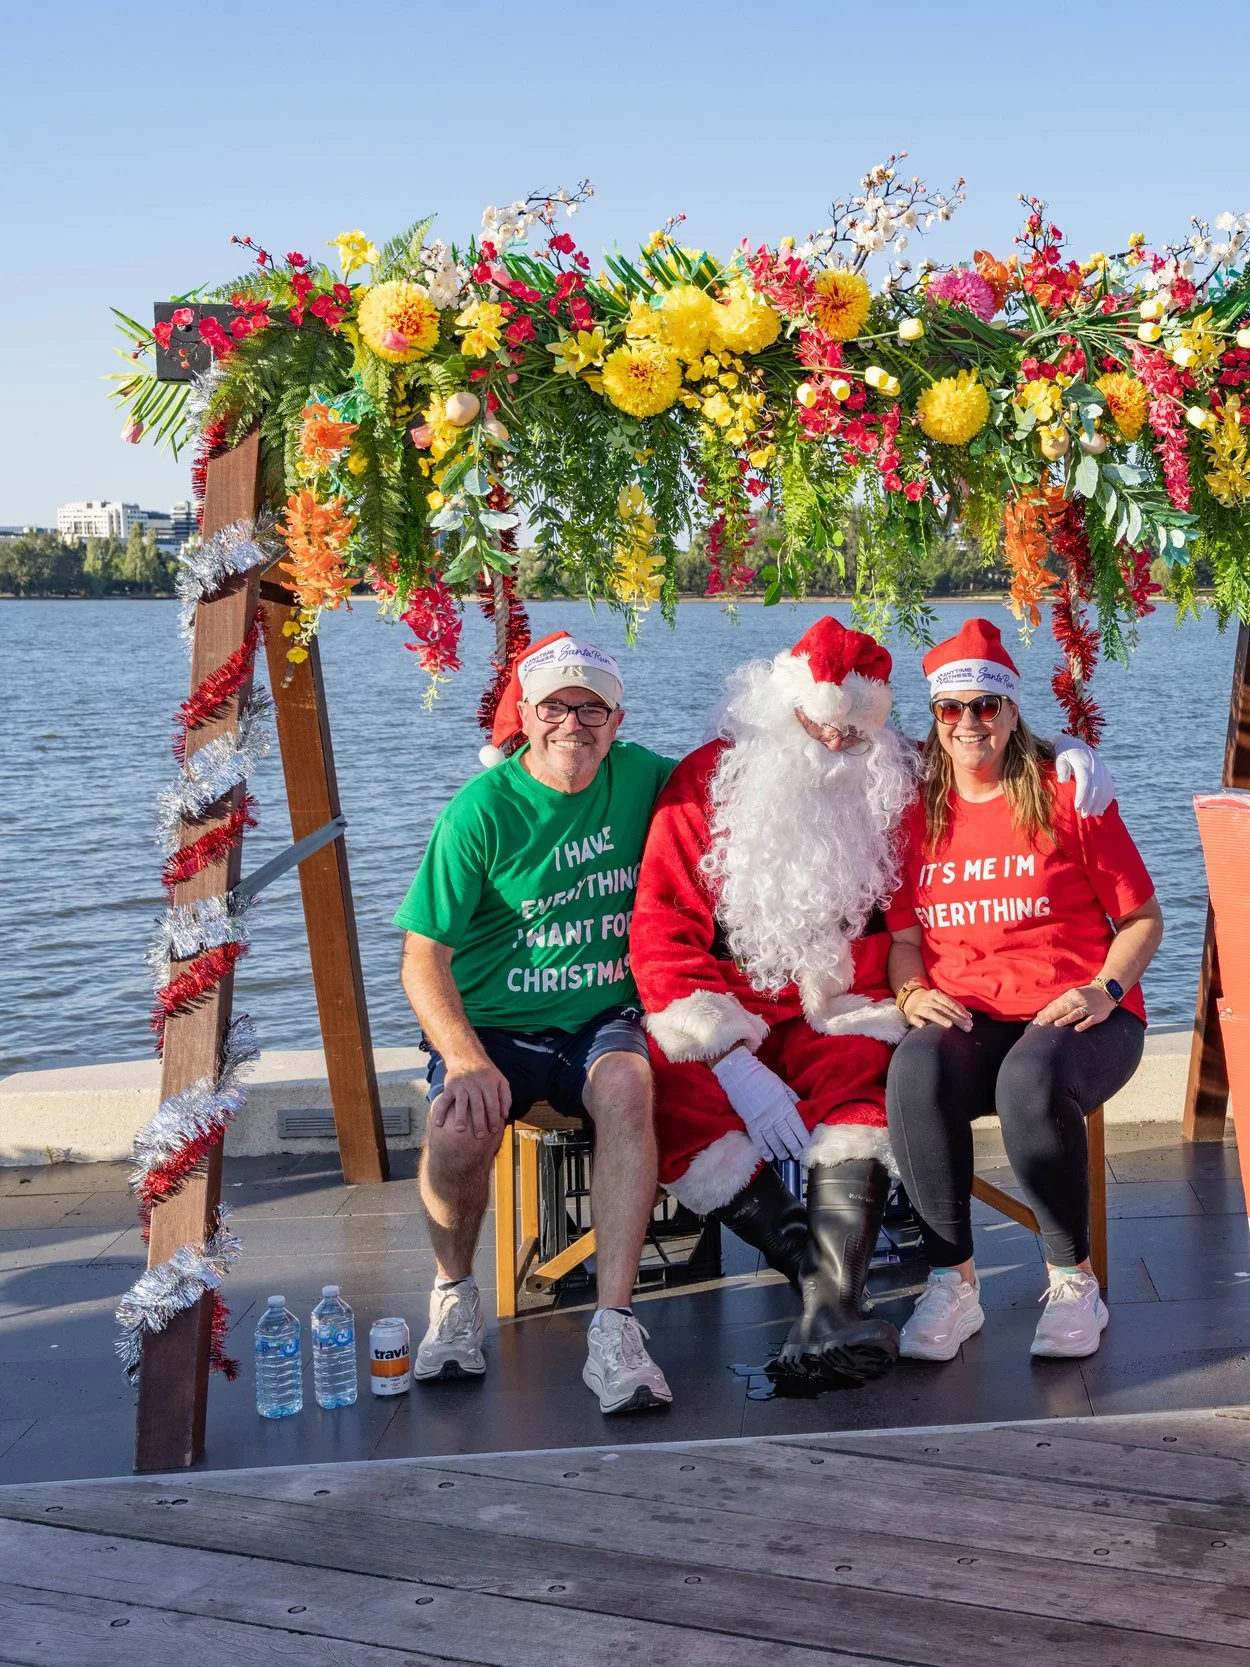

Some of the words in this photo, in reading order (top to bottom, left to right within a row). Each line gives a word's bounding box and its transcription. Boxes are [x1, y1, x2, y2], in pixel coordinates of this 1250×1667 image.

[555, 846, 561, 872] I
[564, 826, 615, 869] HAVE
[919, 861, 956, 887] IT'S
[963, 857, 998, 882] ME
[1003, 854, 1035, 878] I'M
[914, 896, 1051, 929] EVERYTHING
[526, 919, 595, 948] WANT
